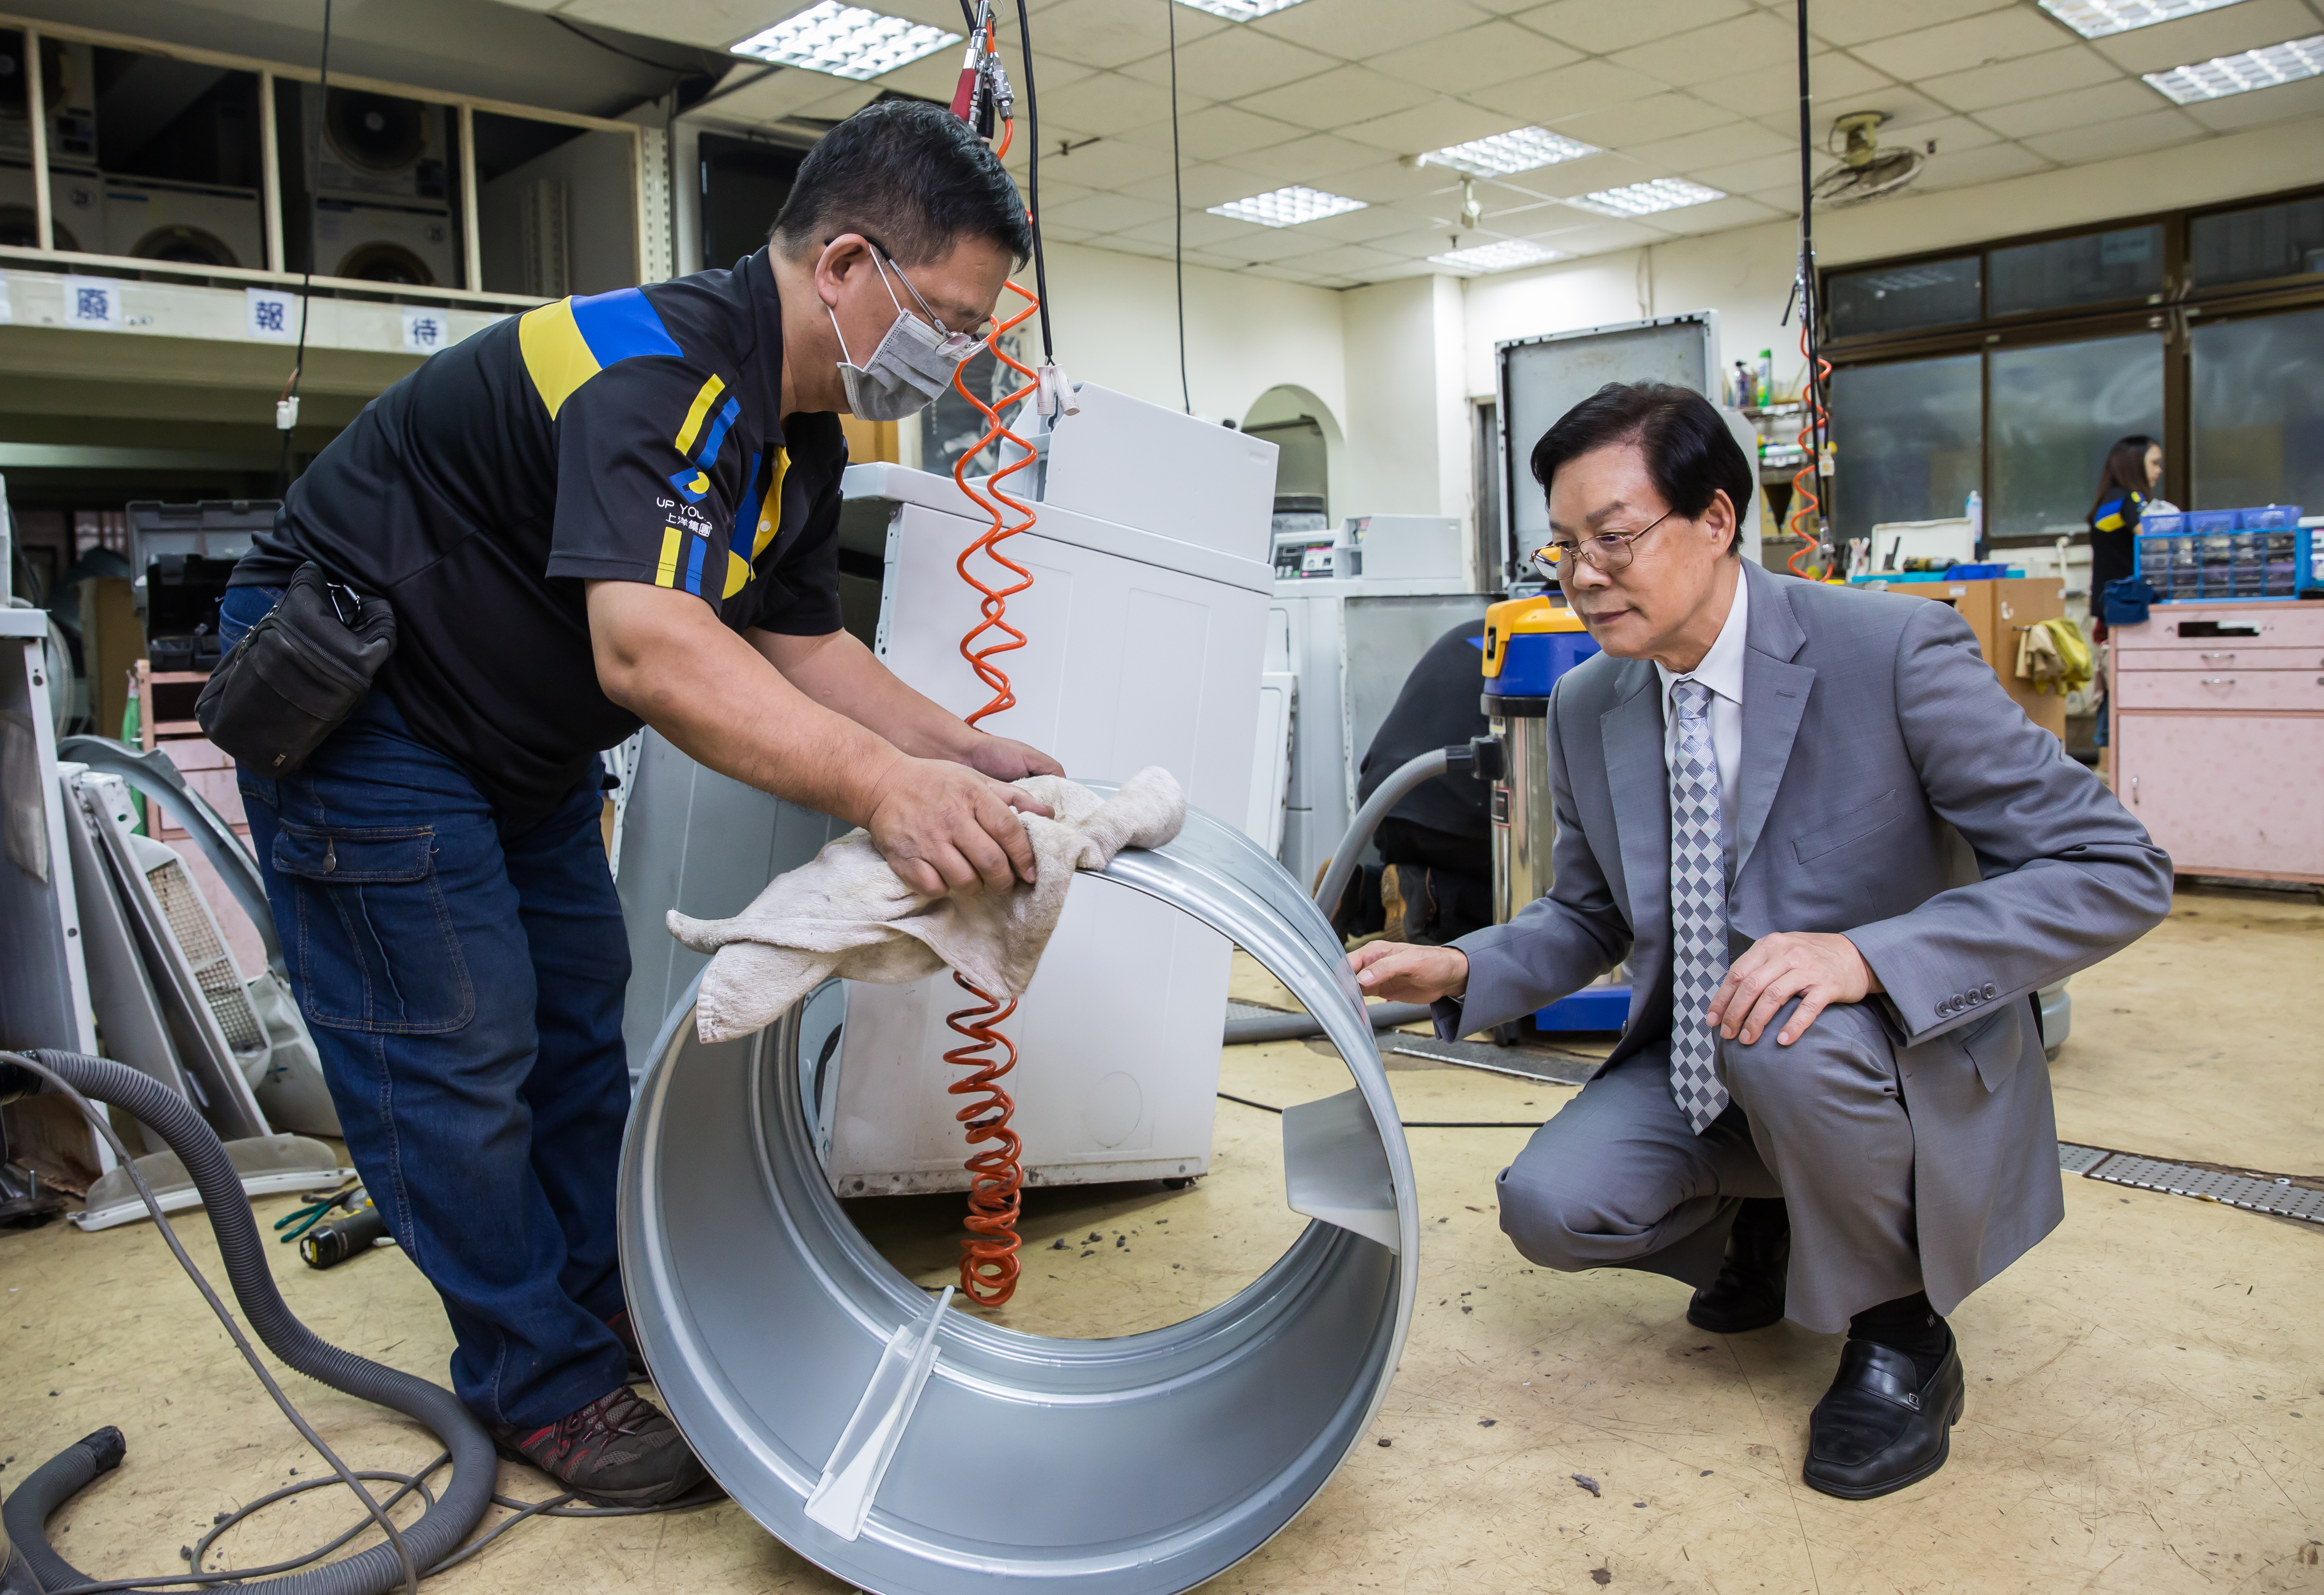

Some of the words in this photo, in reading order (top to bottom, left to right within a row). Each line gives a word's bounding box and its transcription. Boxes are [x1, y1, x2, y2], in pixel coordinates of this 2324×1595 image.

[256, 301, 284, 331] 報
[413, 317, 437, 345] 待
[656, 497, 675, 509] UP
[665, 512, 710, 537] 上洋集團
